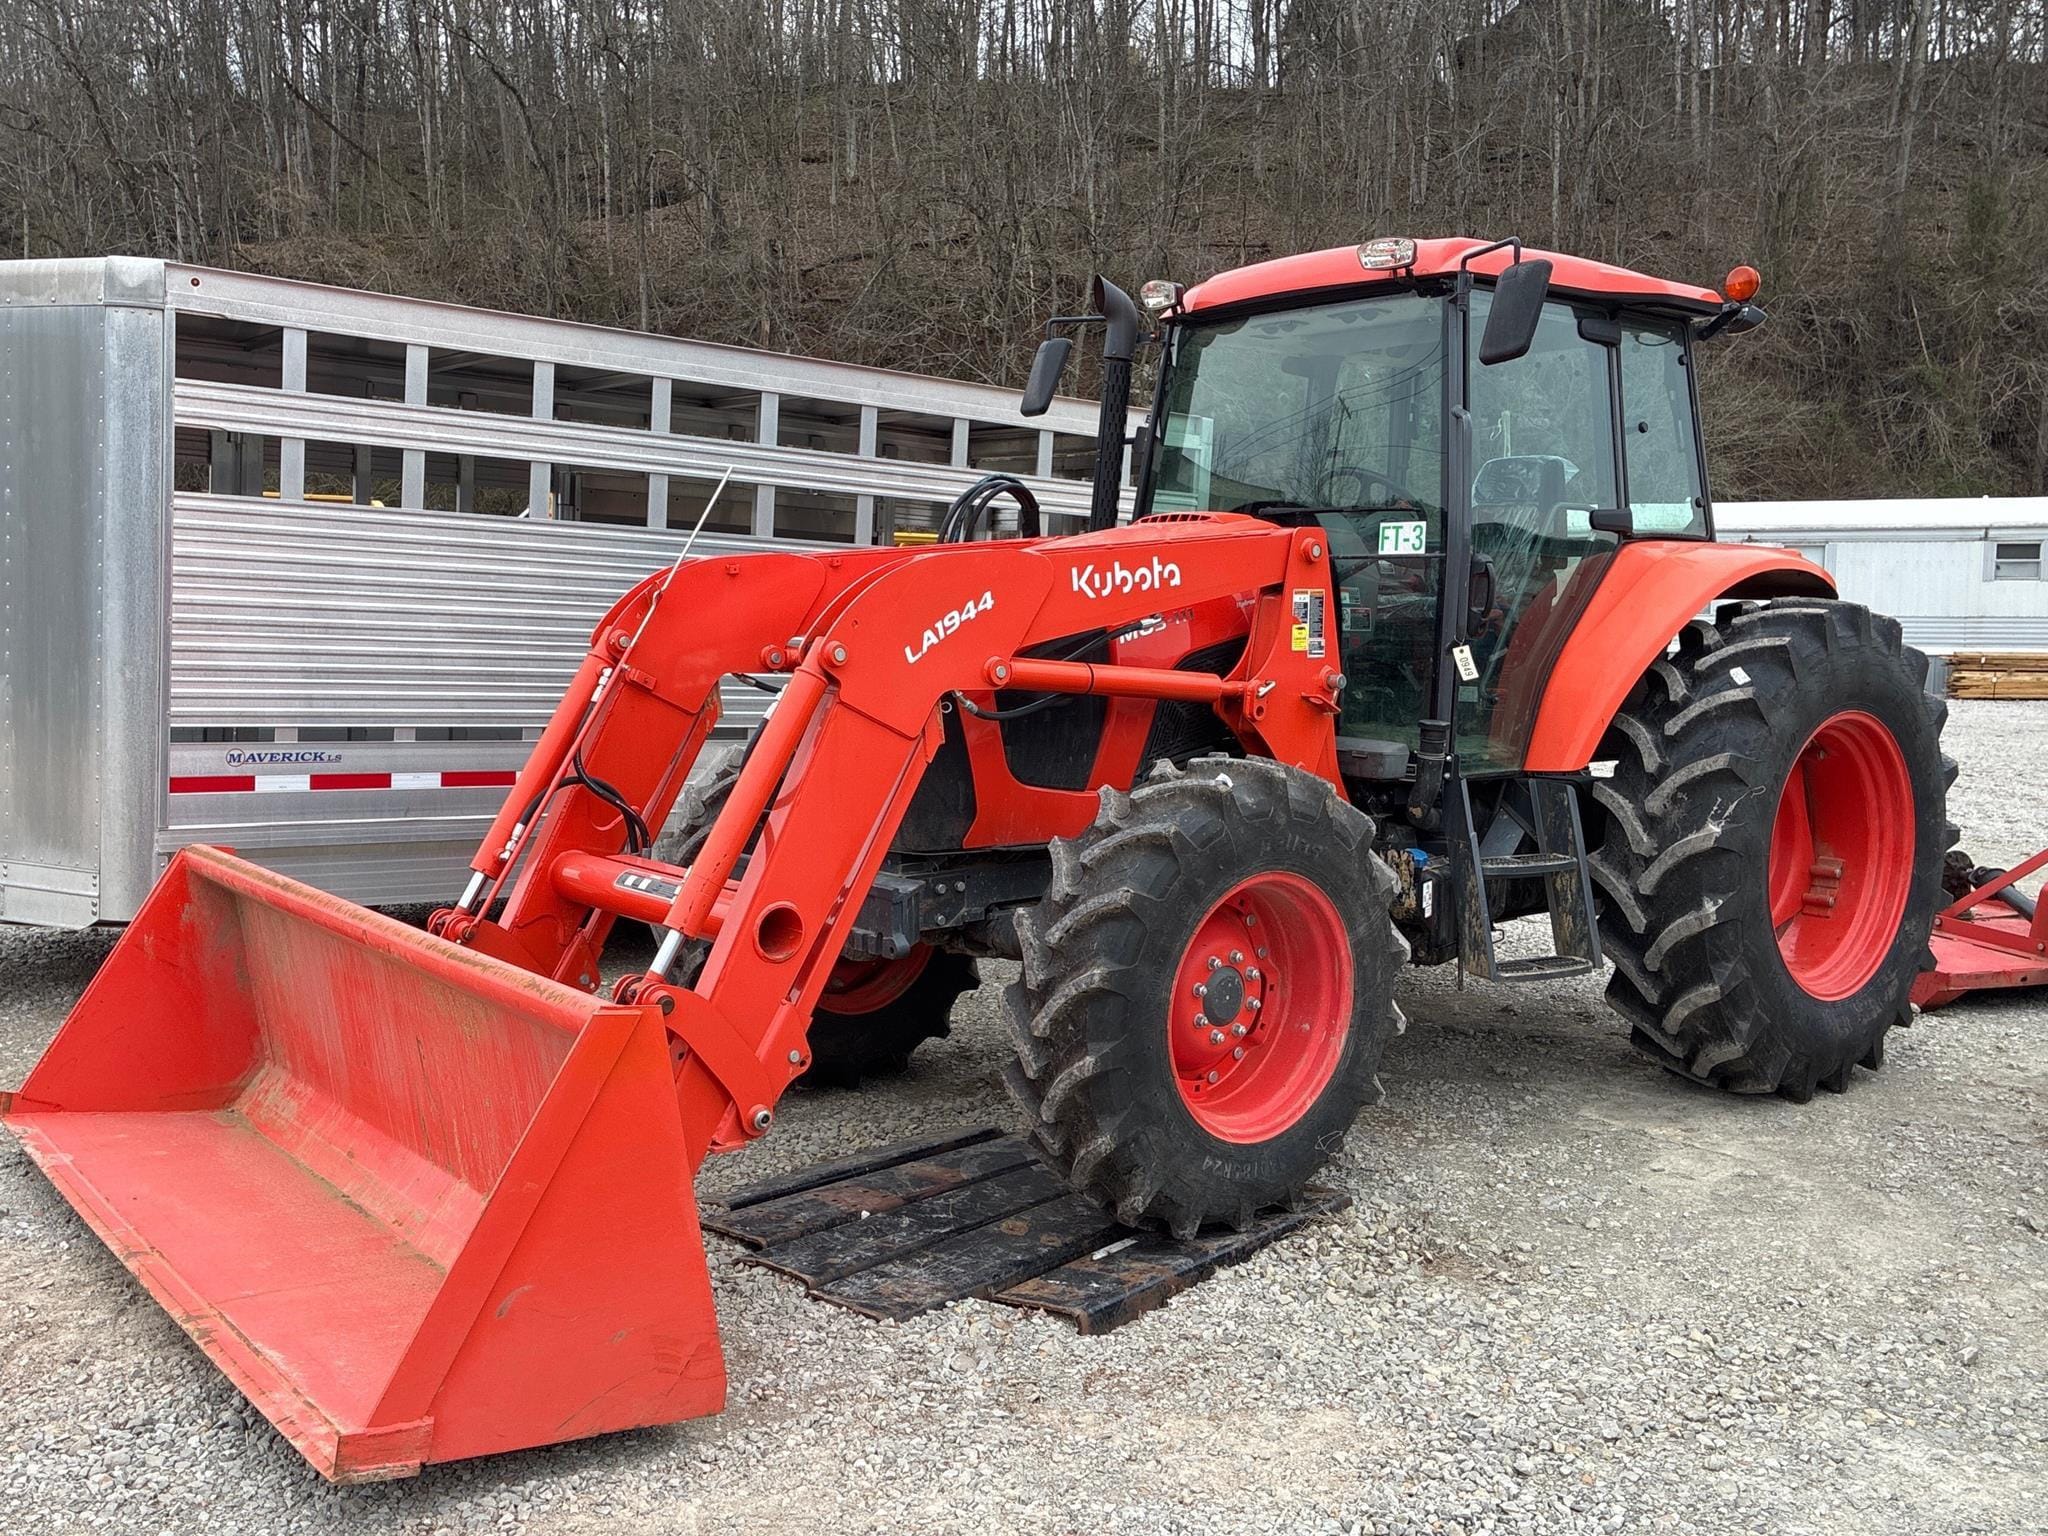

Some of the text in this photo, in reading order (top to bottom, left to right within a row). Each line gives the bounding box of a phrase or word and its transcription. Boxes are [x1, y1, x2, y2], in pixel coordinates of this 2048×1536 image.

[1380, 524, 1424, 552] FT-3
[1071, 555, 1181, 599] Kubota
[904, 590, 995, 665] LA1944
[1459, 656, 1474, 677] 0949
[226, 749, 343, 766] MAVERICK LS
